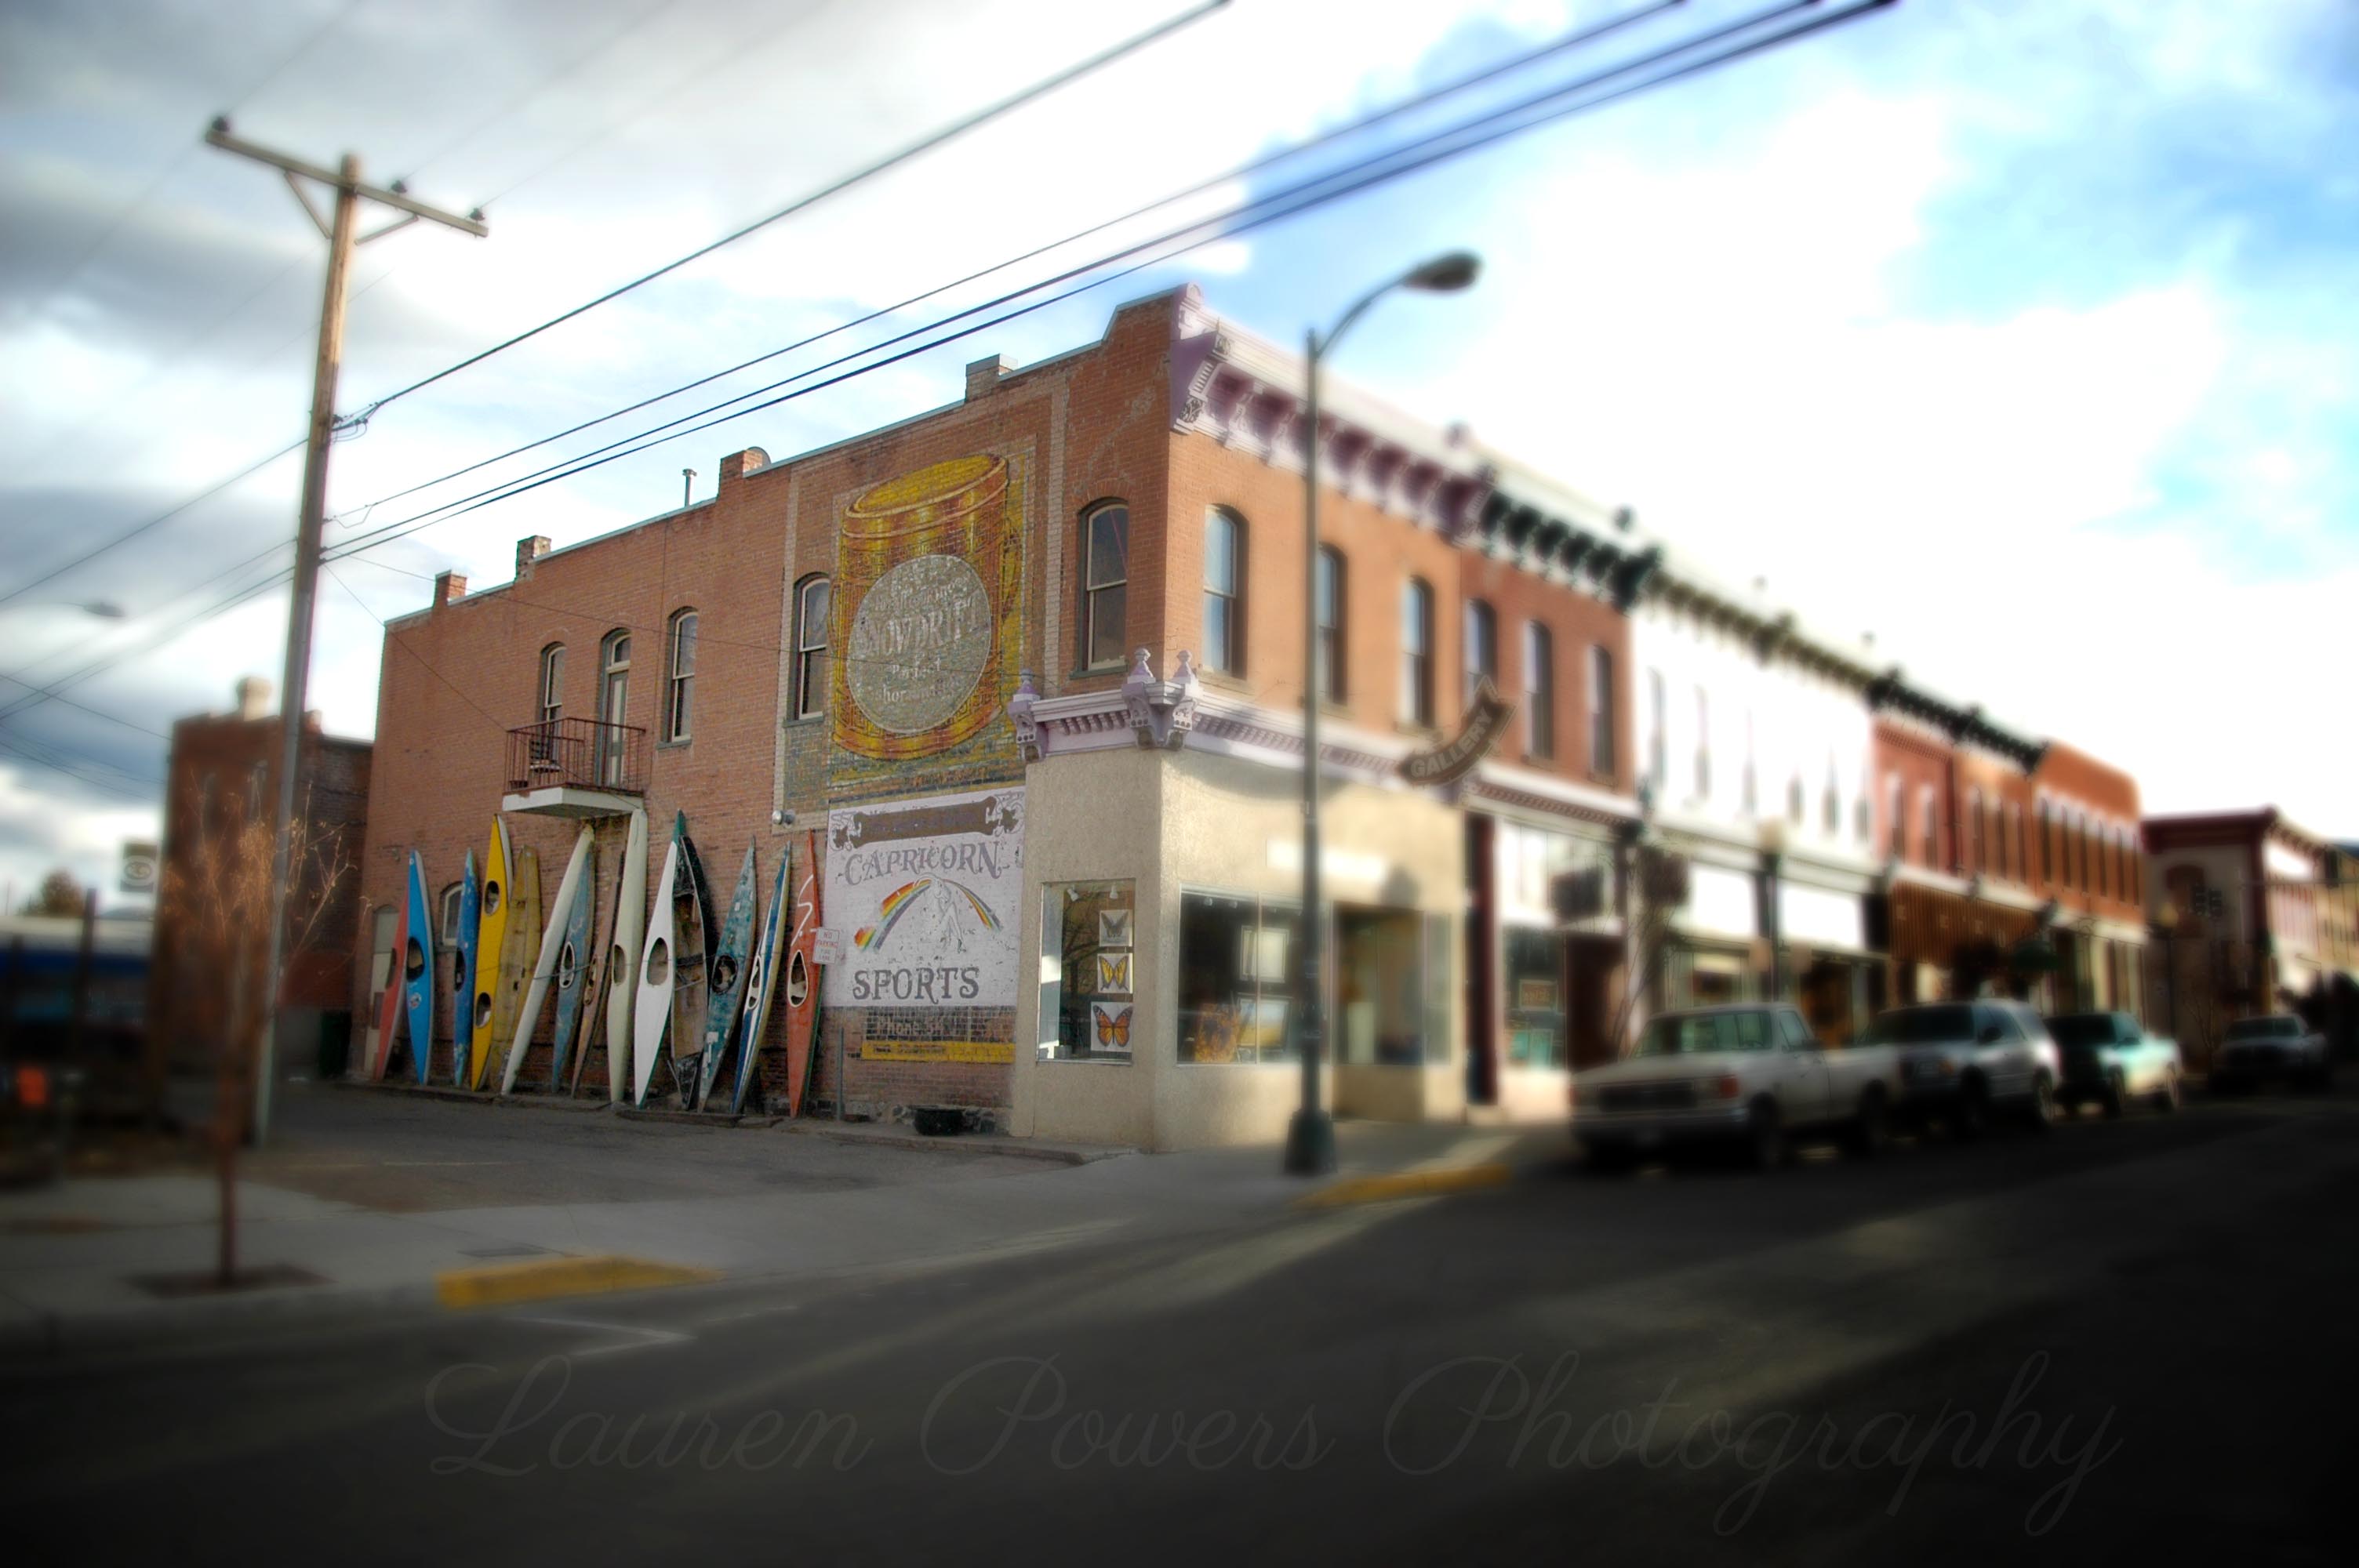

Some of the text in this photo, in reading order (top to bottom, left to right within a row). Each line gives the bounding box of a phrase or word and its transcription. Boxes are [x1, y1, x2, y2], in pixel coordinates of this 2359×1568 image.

[1412, 706, 1492, 779] GALLERY
[844, 840, 1003, 886] CAPRICORN
[852, 967, 980, 1004] SPORTS
